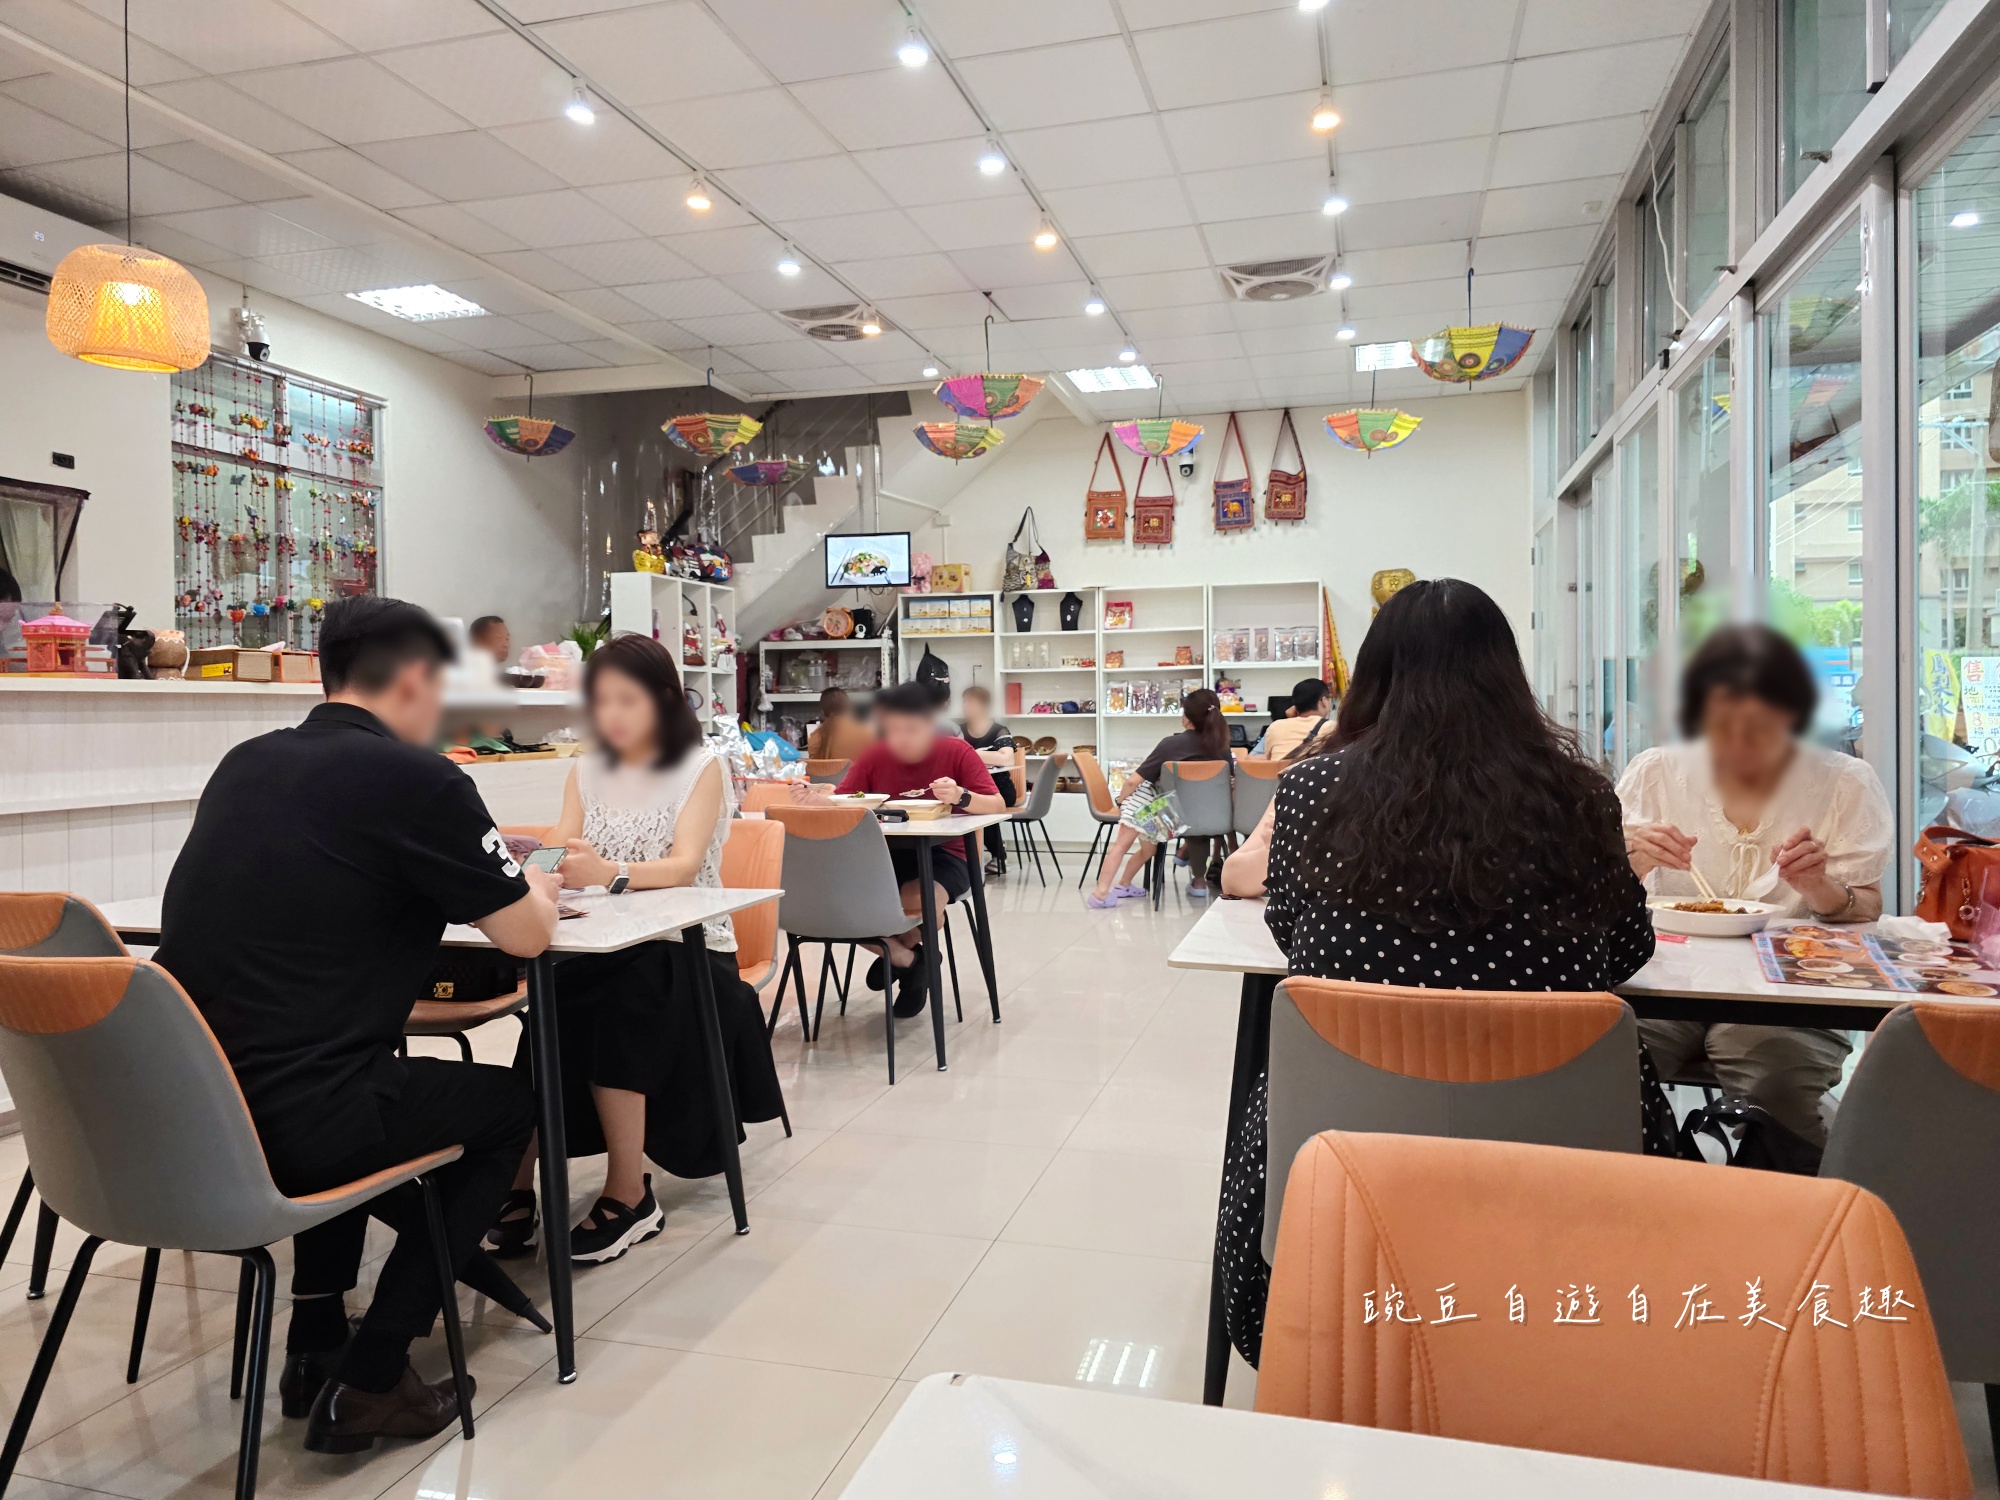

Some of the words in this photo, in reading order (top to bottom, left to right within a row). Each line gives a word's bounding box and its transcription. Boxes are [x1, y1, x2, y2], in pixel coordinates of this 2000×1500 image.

[1931, 653, 1955, 718] 鳳梨冰
[481, 826, 520, 878] 3
